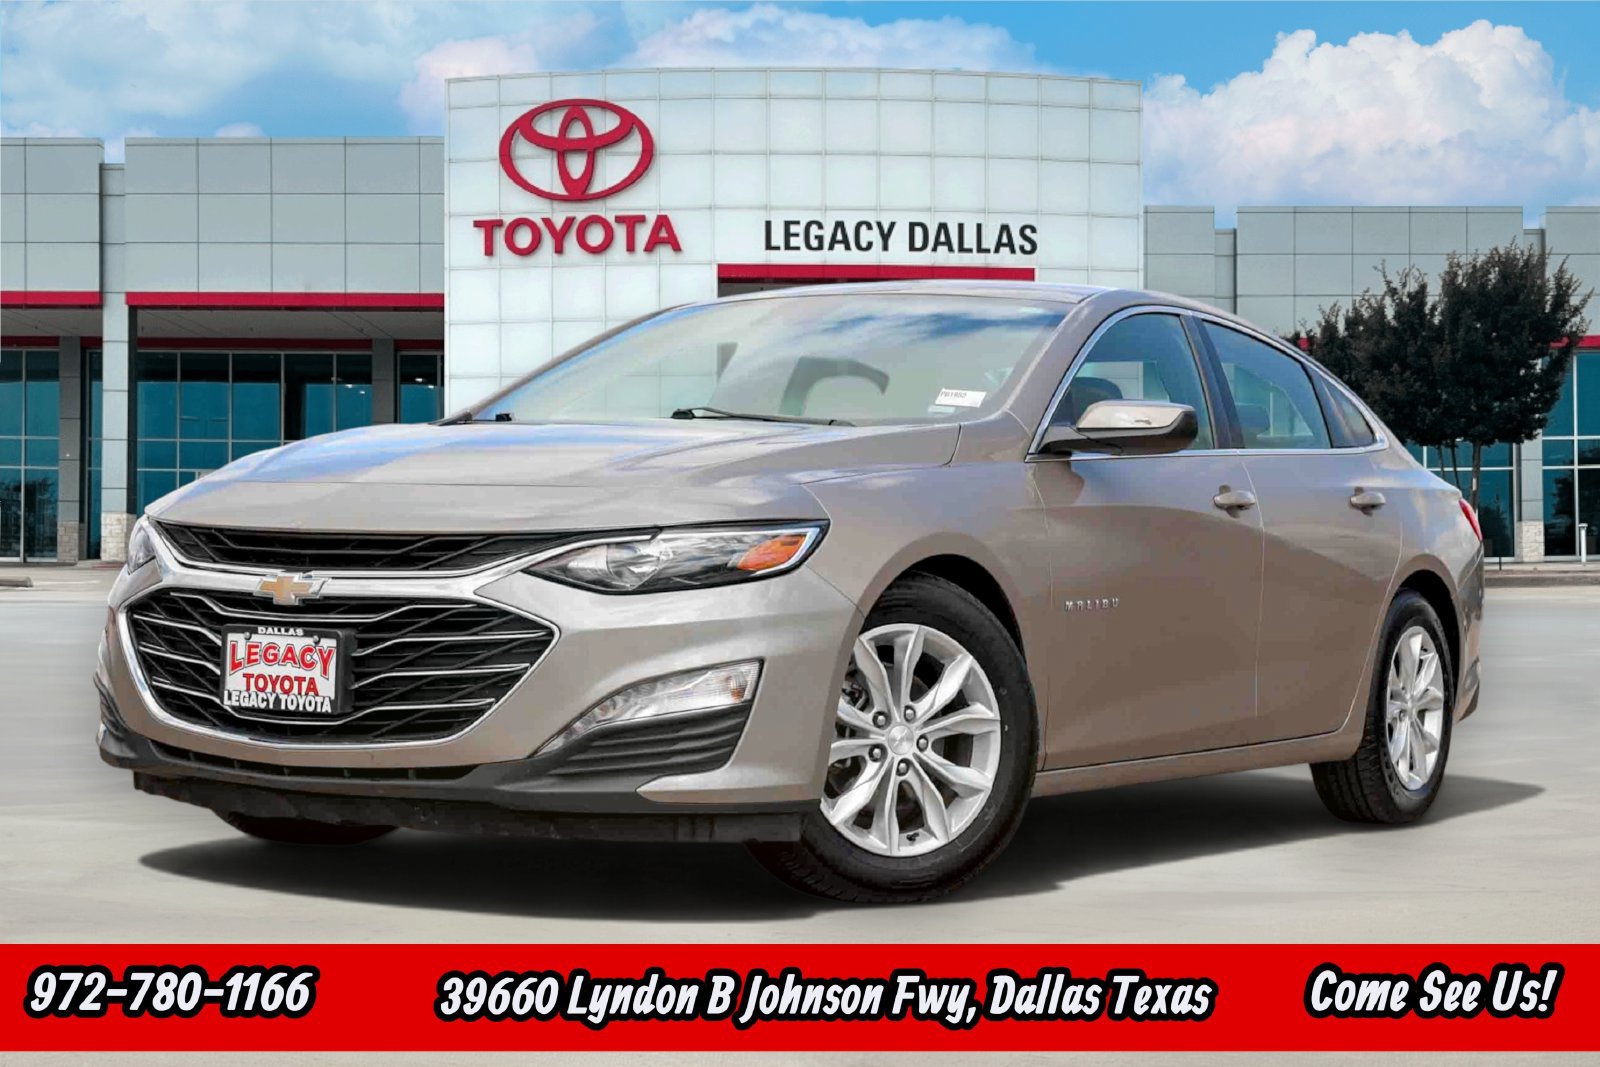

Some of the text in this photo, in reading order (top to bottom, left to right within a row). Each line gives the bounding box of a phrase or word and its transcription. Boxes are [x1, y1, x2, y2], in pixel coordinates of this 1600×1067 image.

[473, 214, 682, 257] TOYOTA
[764, 219, 1039, 256] LEGACY DALLAS
[1065, 597, 1119, 611] MALIBU
[257, 626, 304, 636] DALLAS
[229, 640, 337, 681] LEGACY
[242, 673, 320, 696] TOYOTA
[223, 690, 332, 713] LEGACY TOYOTA
